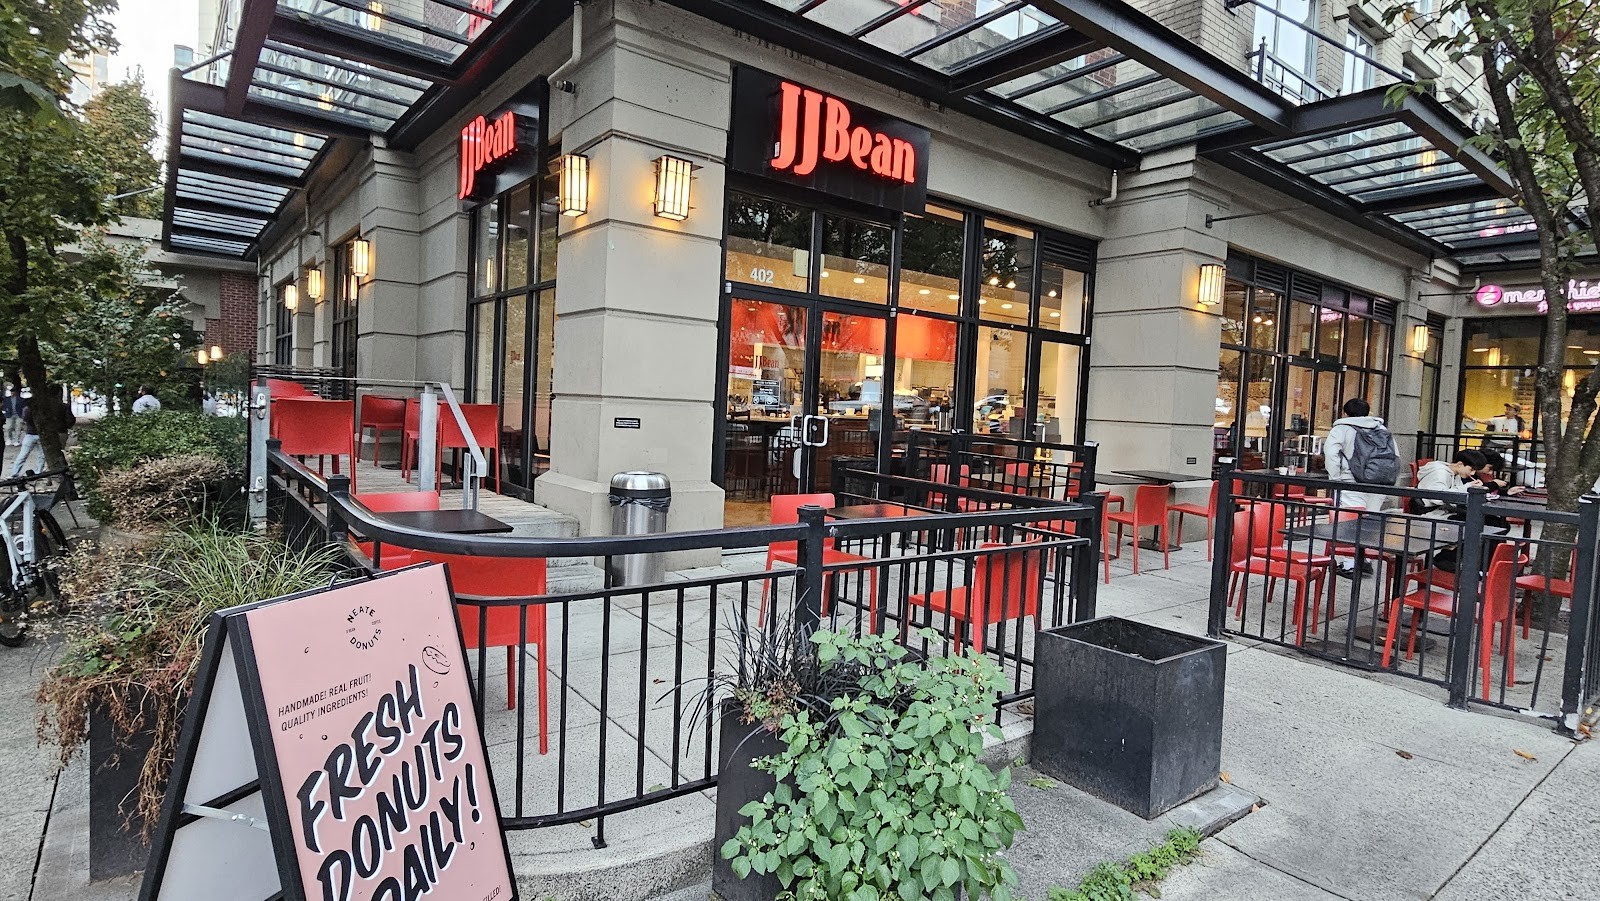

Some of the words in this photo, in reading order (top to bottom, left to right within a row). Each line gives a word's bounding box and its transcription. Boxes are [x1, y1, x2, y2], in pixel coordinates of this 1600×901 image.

[750, 267, 774, 284] 402
[347, 606, 376, 623] NEATE
[350, 629, 381, 650] DONUTS
[278, 690, 327, 717] HANDMADE!
[329, 683, 348, 698] REAL
[349, 673, 371, 690] FRUIT!
[281, 709, 315, 731] QUALITY
[317, 688, 368, 717] INGREDIENTS!
[297, 663, 425, 854] FRESH
[317, 702, 464, 901] DONUTS
